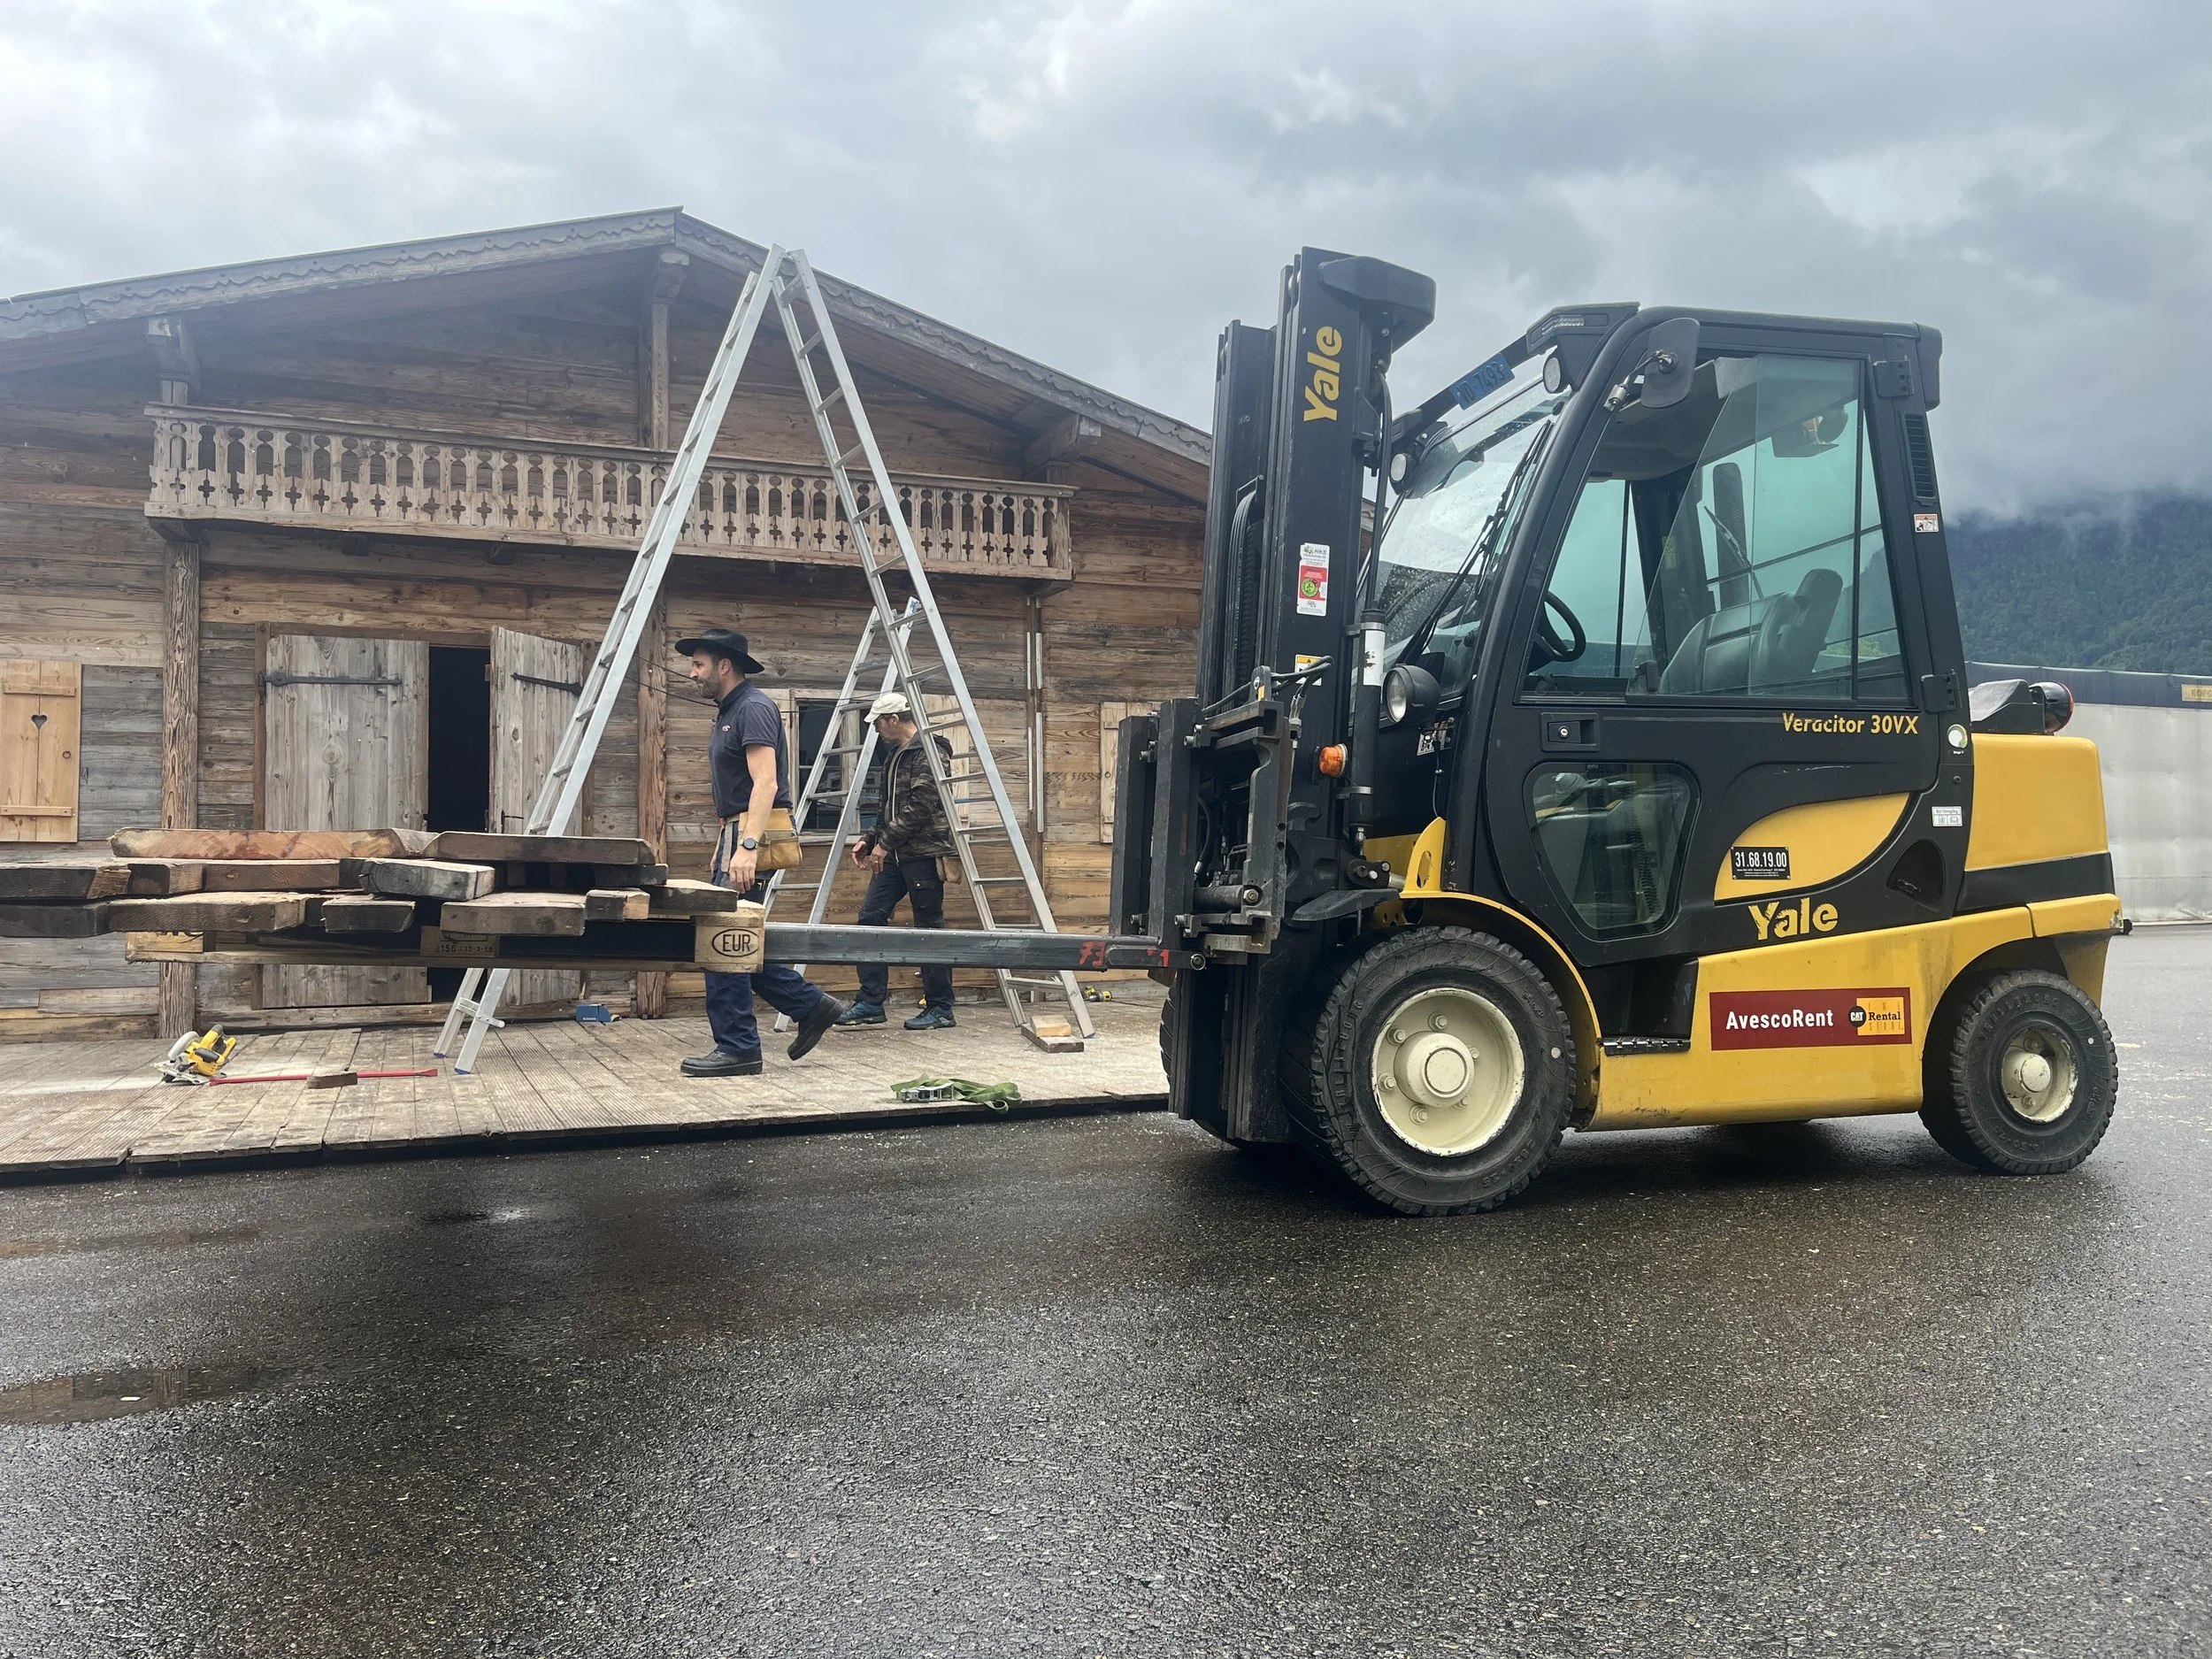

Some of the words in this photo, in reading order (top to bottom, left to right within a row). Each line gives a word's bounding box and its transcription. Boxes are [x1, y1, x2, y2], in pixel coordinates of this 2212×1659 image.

[1303, 326, 1343, 422] Yale
[1782, 712, 1865, 733] Veracitor
[1870, 714, 1919, 734] 30VX
[1735, 852, 1787, 867] 31.68.19.00
[1747, 896, 1839, 941] Yale
[722, 933, 751, 952] EUR
[1725, 1009, 1834, 1030] AvescoRent
[1850, 1011, 1864, 1022] CAT
[1868, 1010, 1901, 1021] Rental
